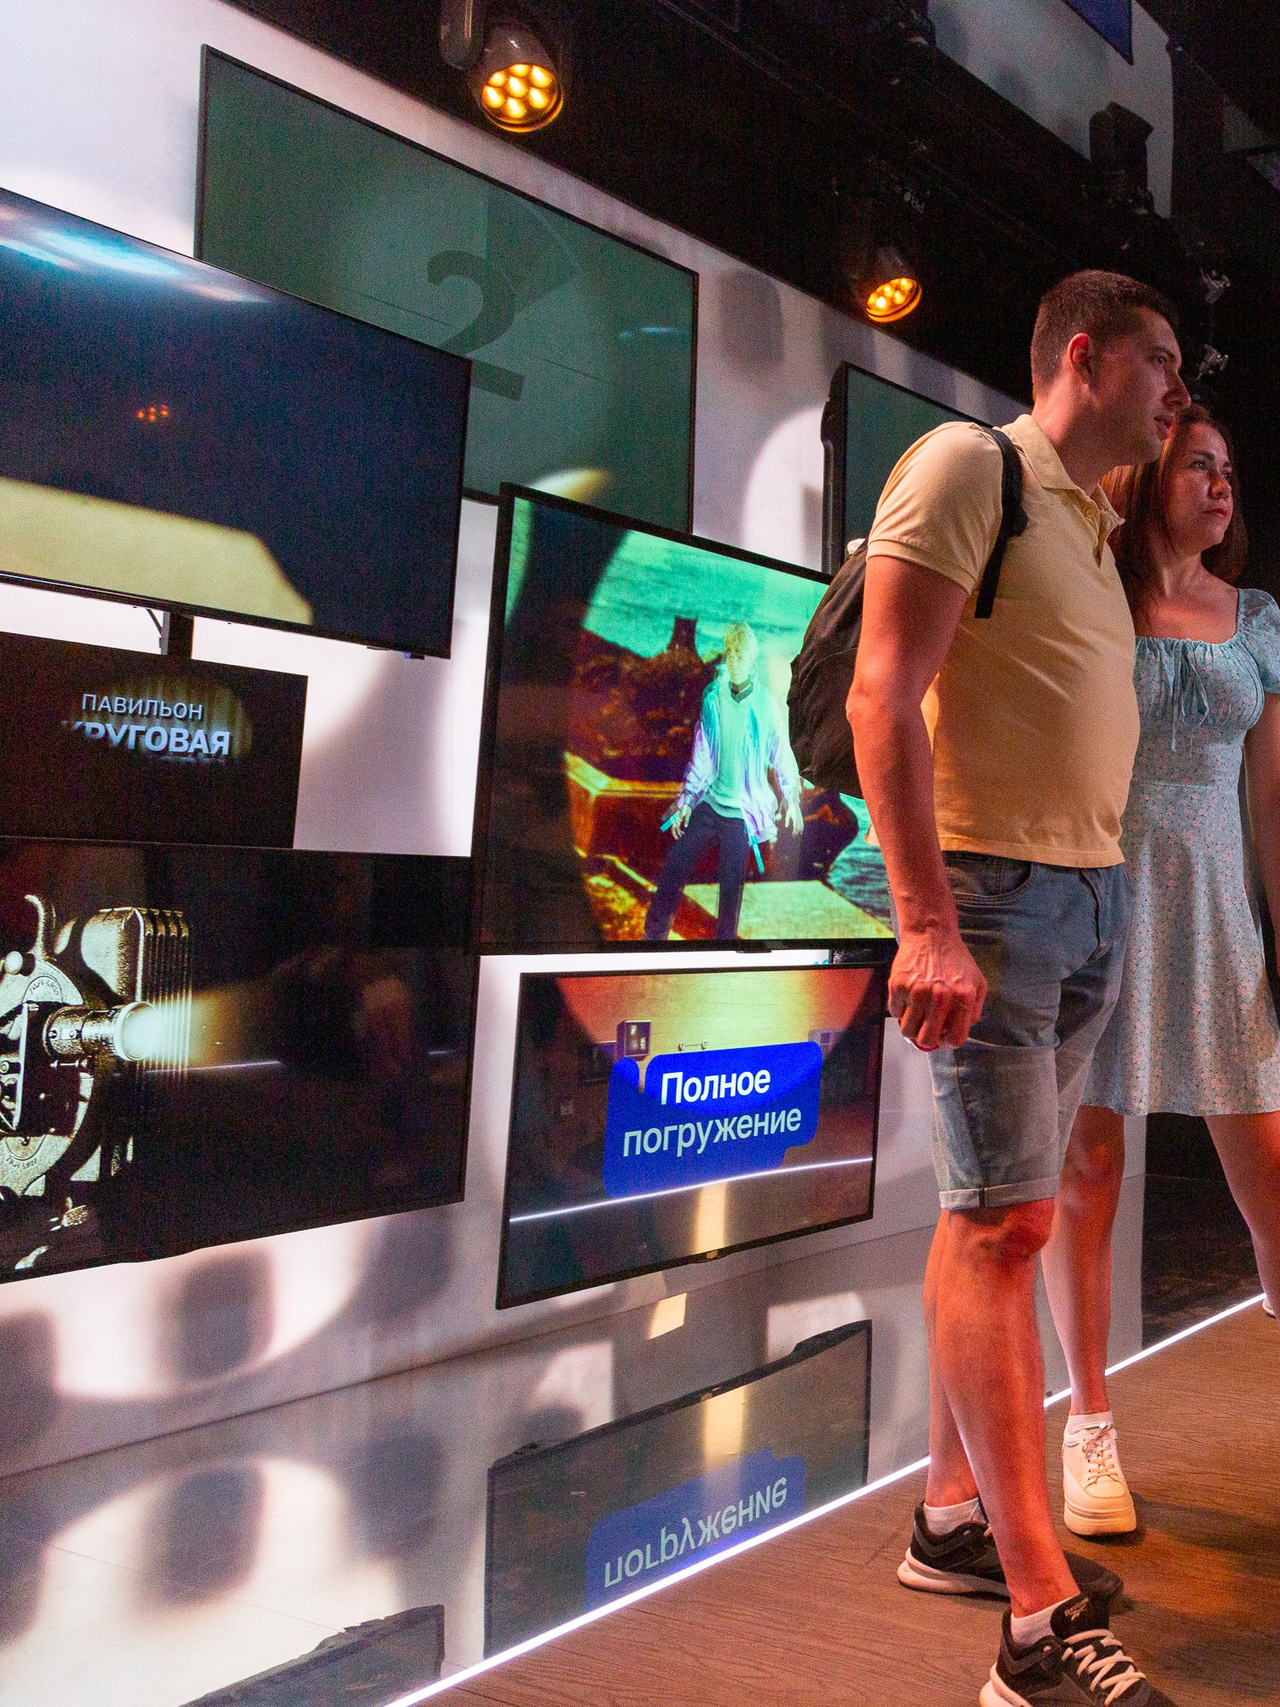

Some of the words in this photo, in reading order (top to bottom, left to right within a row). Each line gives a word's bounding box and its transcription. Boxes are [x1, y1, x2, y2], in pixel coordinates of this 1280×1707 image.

[427, 250, 524, 401] 2
[81, 693, 203, 720] ПАВИЛЬОН
[61, 721, 231, 756] РУГОВАЯ
[660, 1069, 771, 1106] Полное
[622, 1107, 802, 1158] погружение
